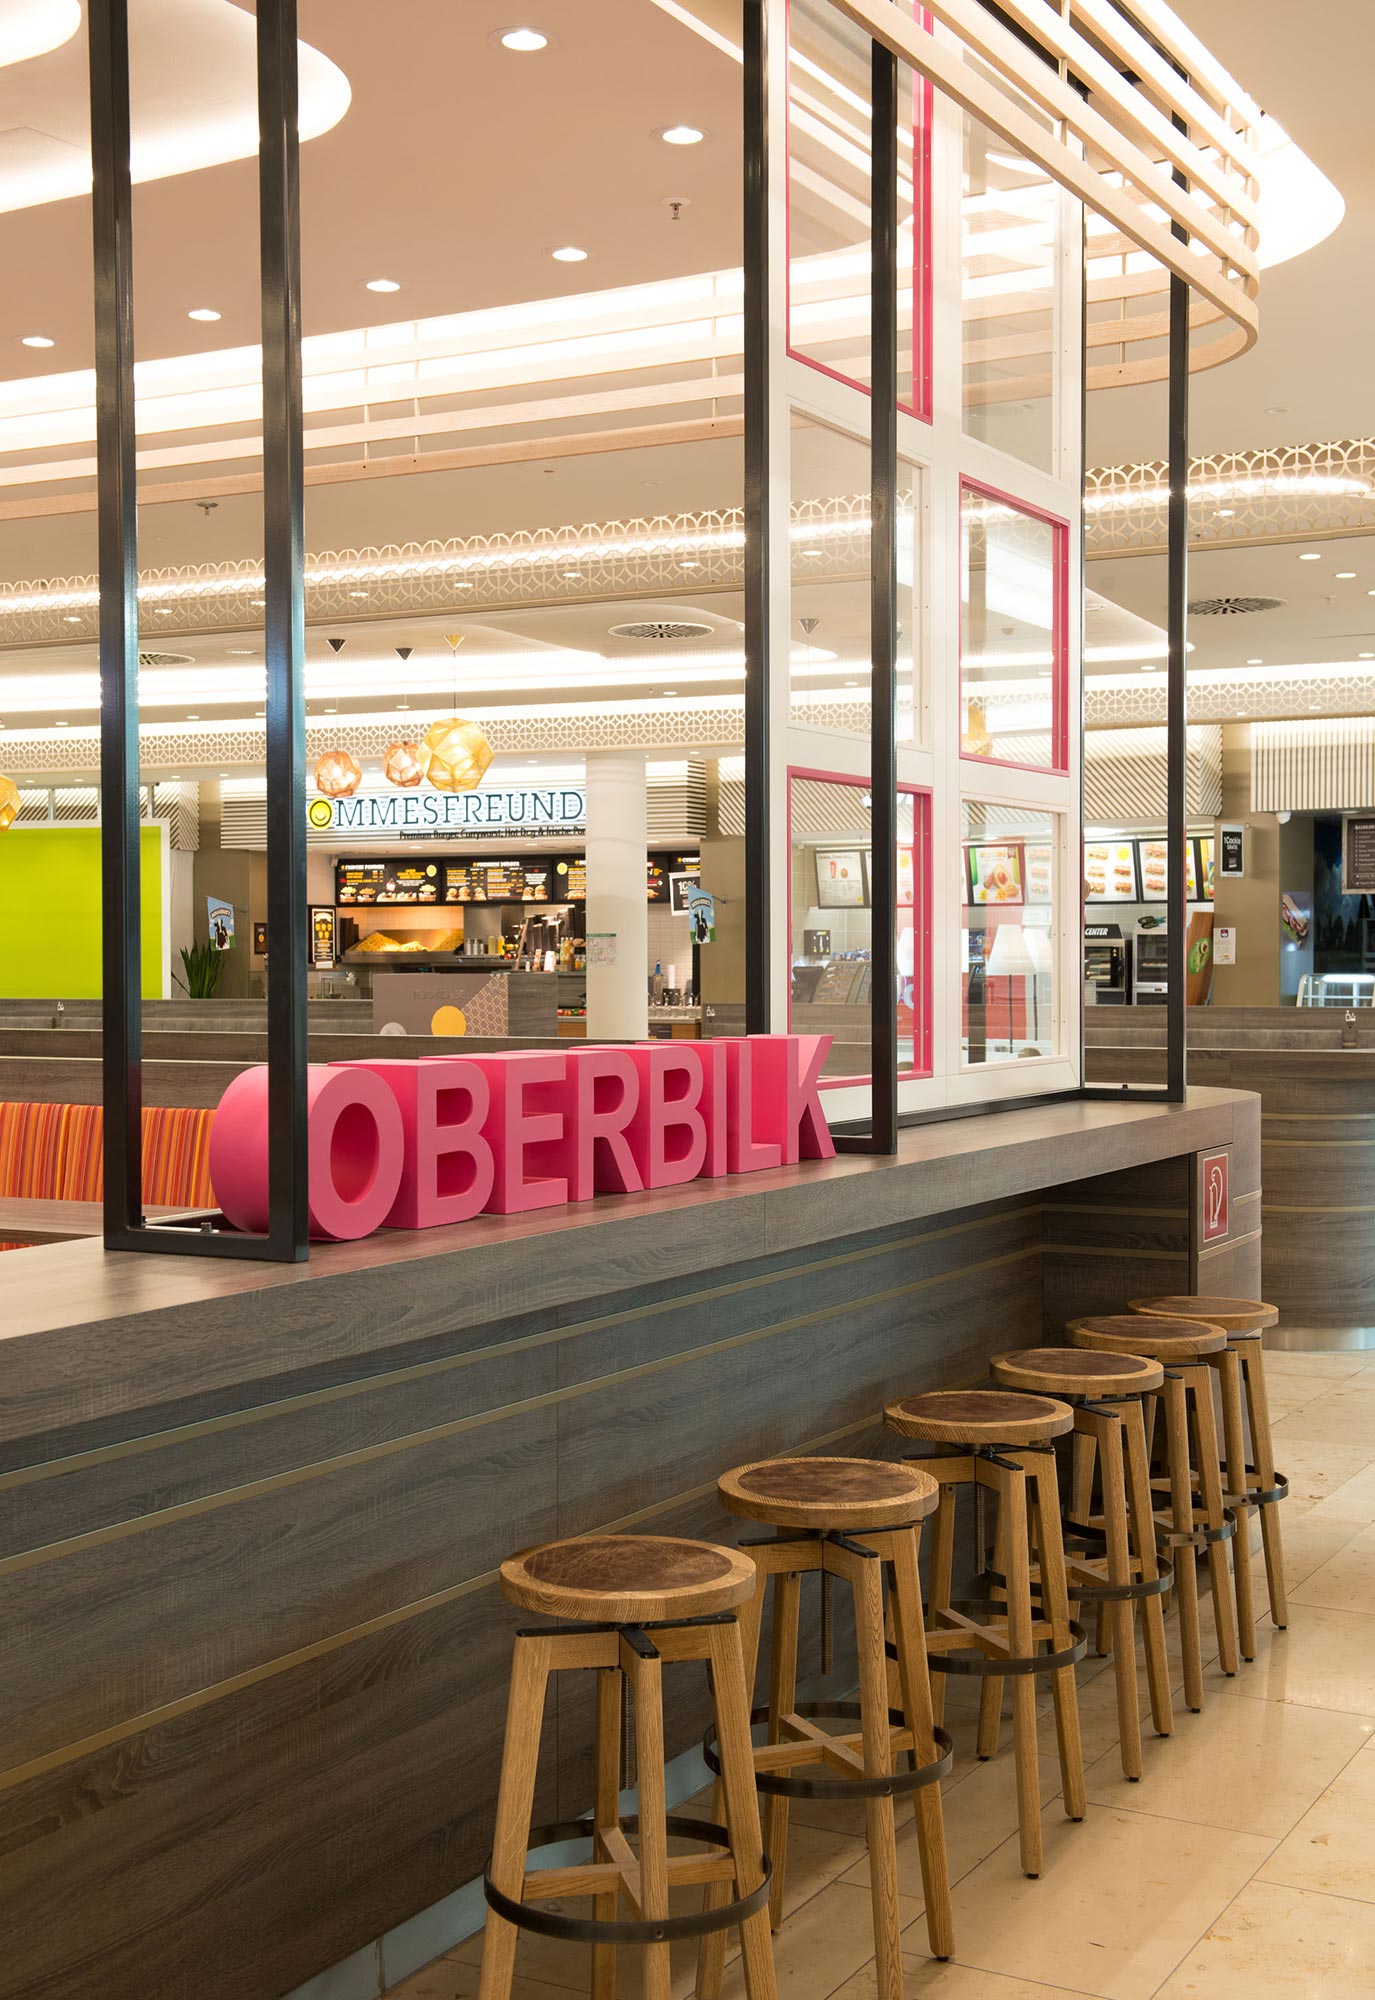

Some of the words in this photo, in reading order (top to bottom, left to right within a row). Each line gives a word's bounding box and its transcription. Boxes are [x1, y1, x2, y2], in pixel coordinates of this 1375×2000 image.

[400, 830, 431, 840] Premium
[505, 827, 518, 837] Hot
[521, 827, 536, 838] Dog
[1085, 927, 1109, 936] CENTER
[300, 1034, 835, 1241] OBERBILK
